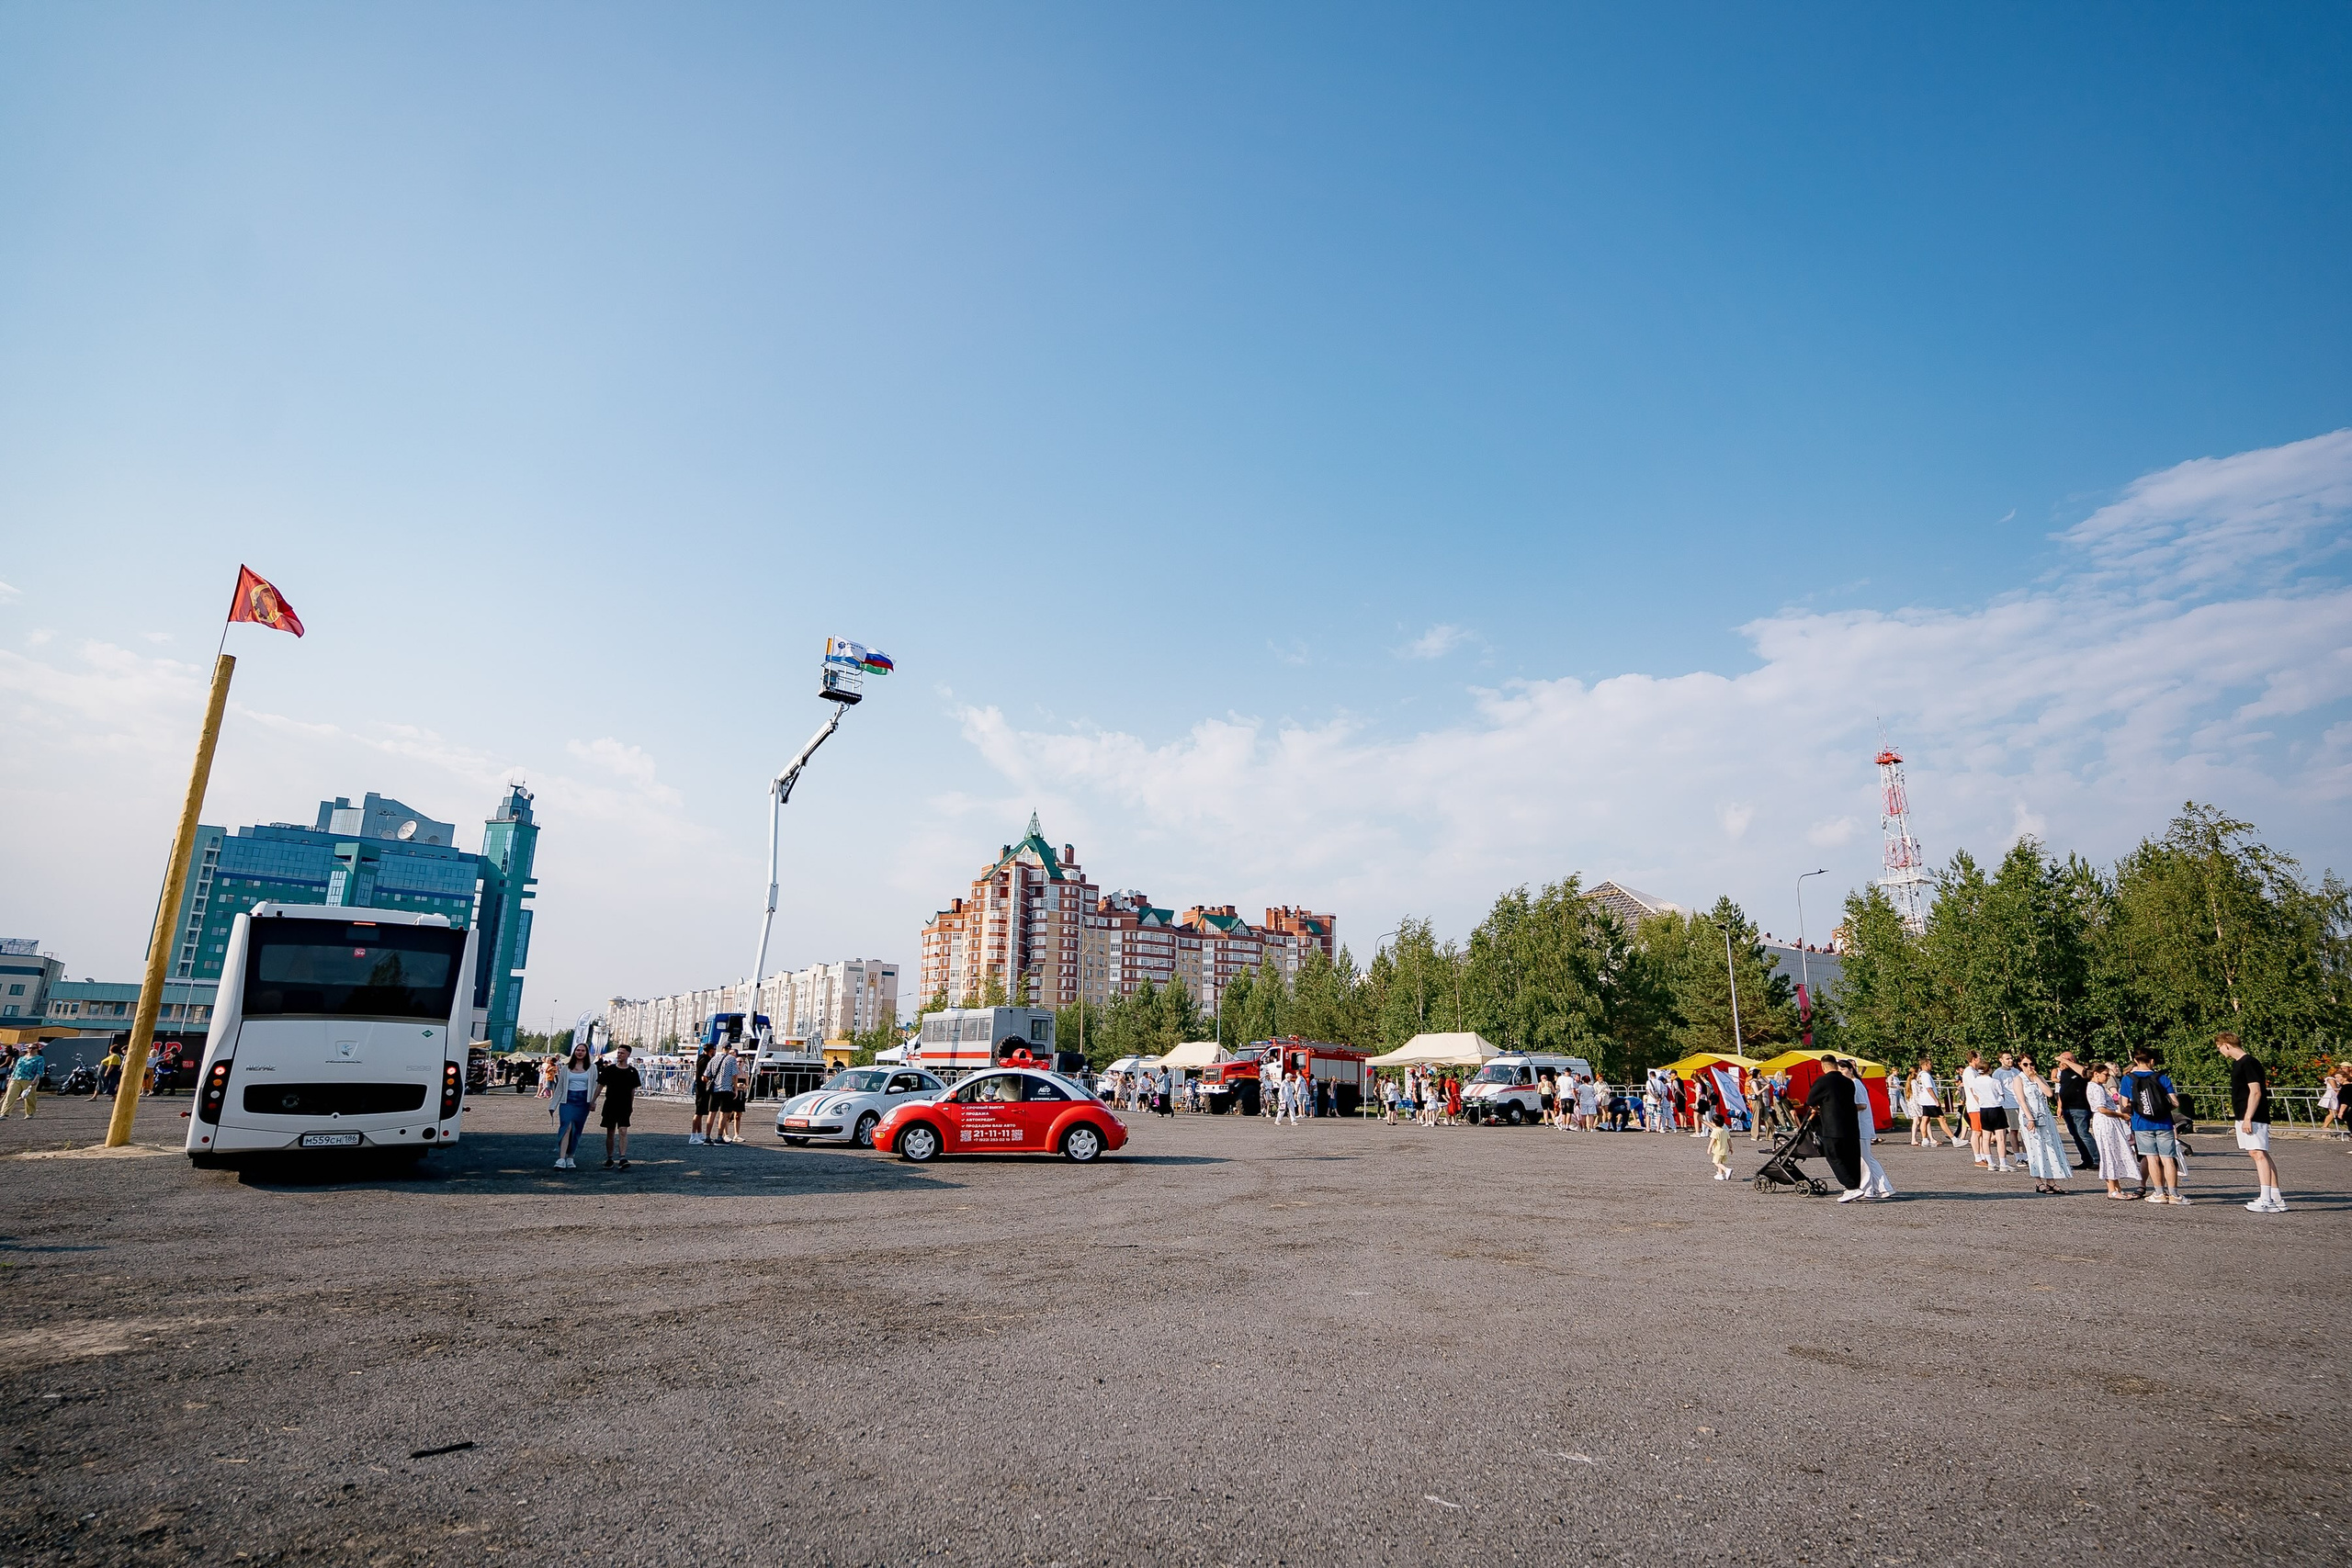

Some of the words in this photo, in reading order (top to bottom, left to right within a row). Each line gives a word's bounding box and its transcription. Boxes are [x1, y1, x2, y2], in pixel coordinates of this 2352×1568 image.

[2140, 1089, 2152, 1115] Reebok
[973, 1129, 1010, 1137] 21-11-11
[305, 1135, 342, 1145] М559СН
